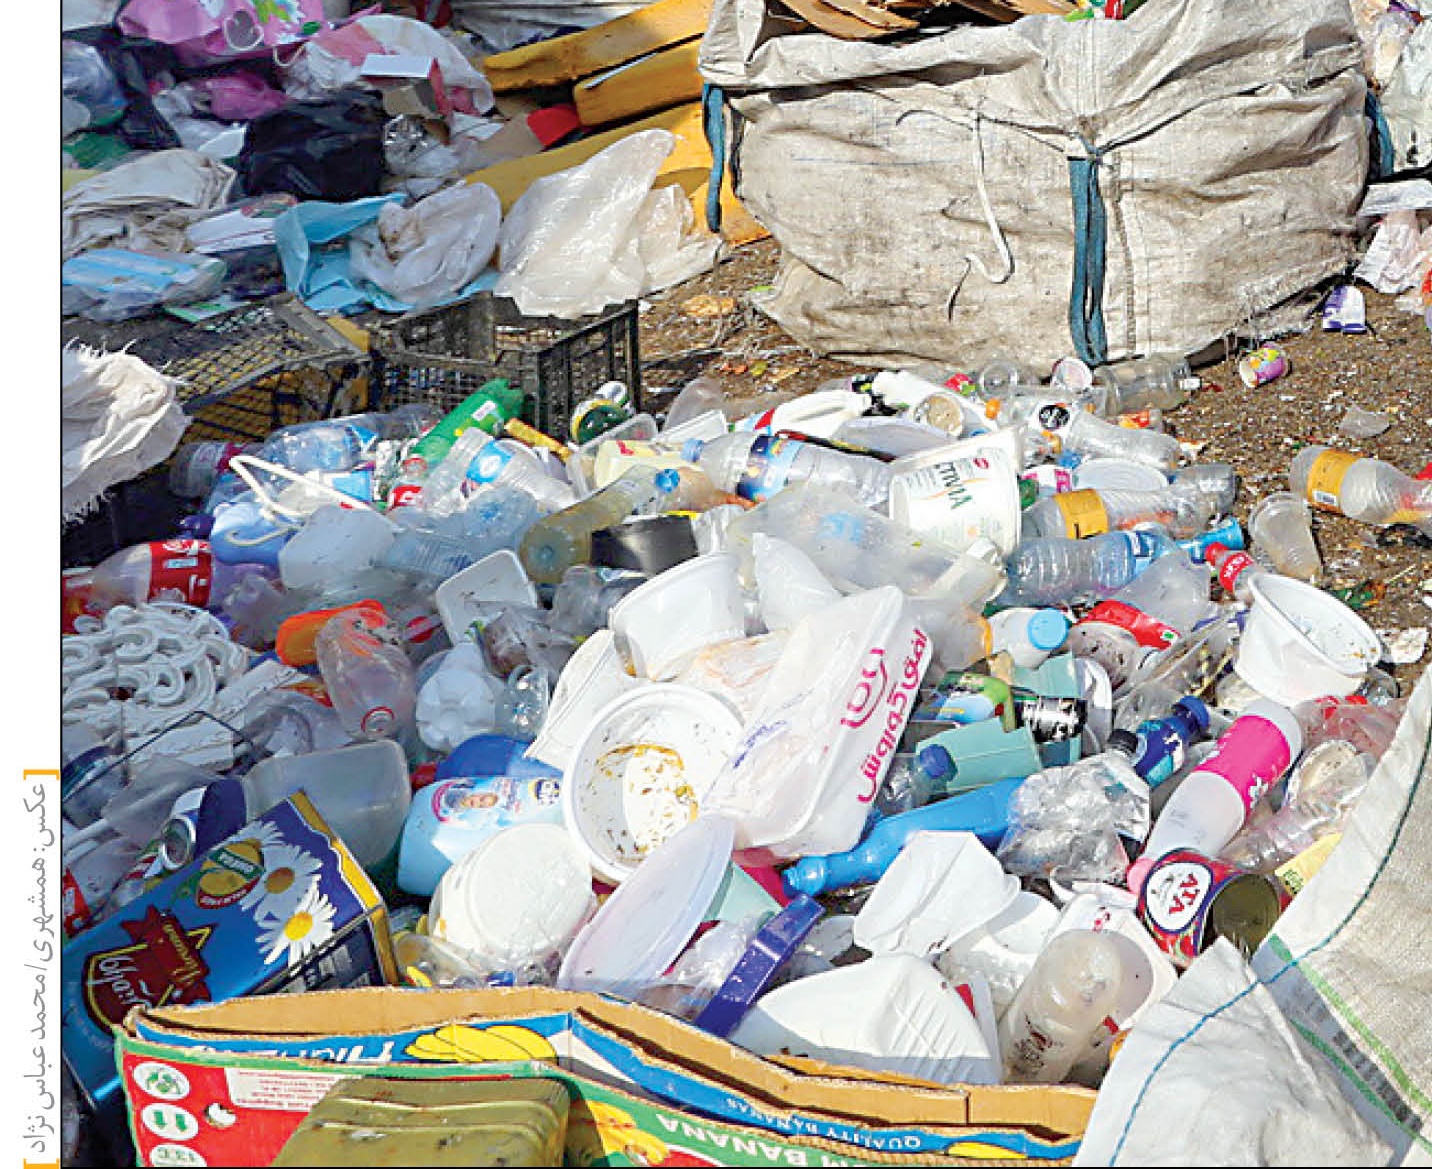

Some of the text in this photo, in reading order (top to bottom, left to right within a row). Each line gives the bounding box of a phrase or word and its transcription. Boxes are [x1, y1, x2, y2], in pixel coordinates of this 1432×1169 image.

[856, 628, 929, 804] افق کوروش
[655, 1113, 808, 1167] BANANA
[723, 1097, 921, 1151] QUALITY BANANAS
